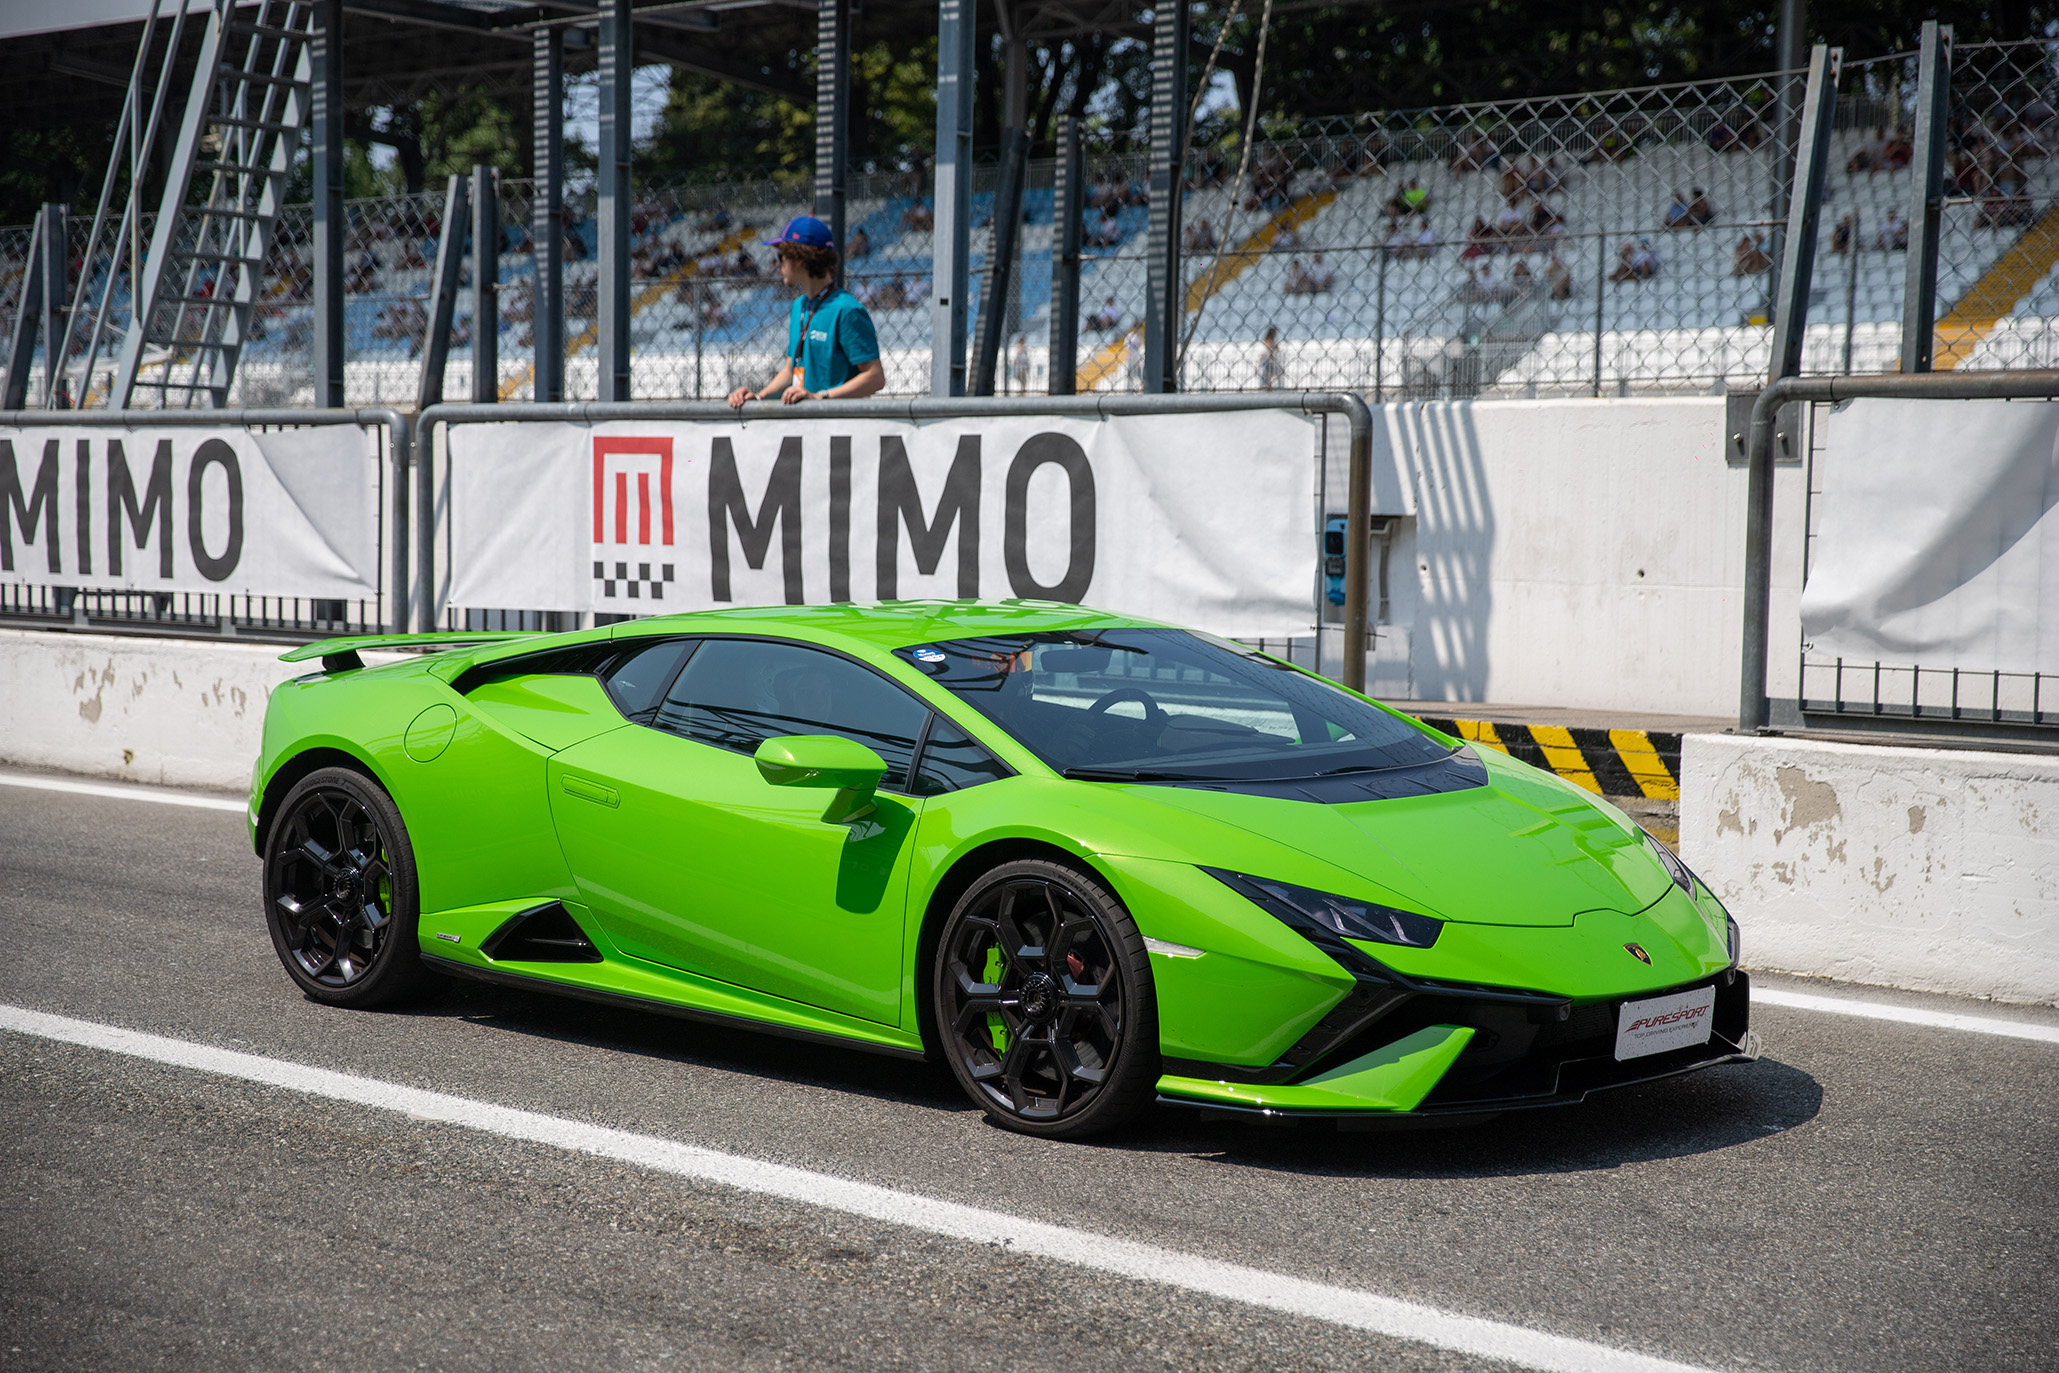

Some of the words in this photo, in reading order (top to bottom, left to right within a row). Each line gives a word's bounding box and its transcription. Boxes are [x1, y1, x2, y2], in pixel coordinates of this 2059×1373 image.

[0, 438, 244, 582] MIMO
[708, 431, 1097, 605] MIMO
[1057, 874, 1087, 897] POTENZA
[1636, 1004, 1710, 1031] PURESPORT
